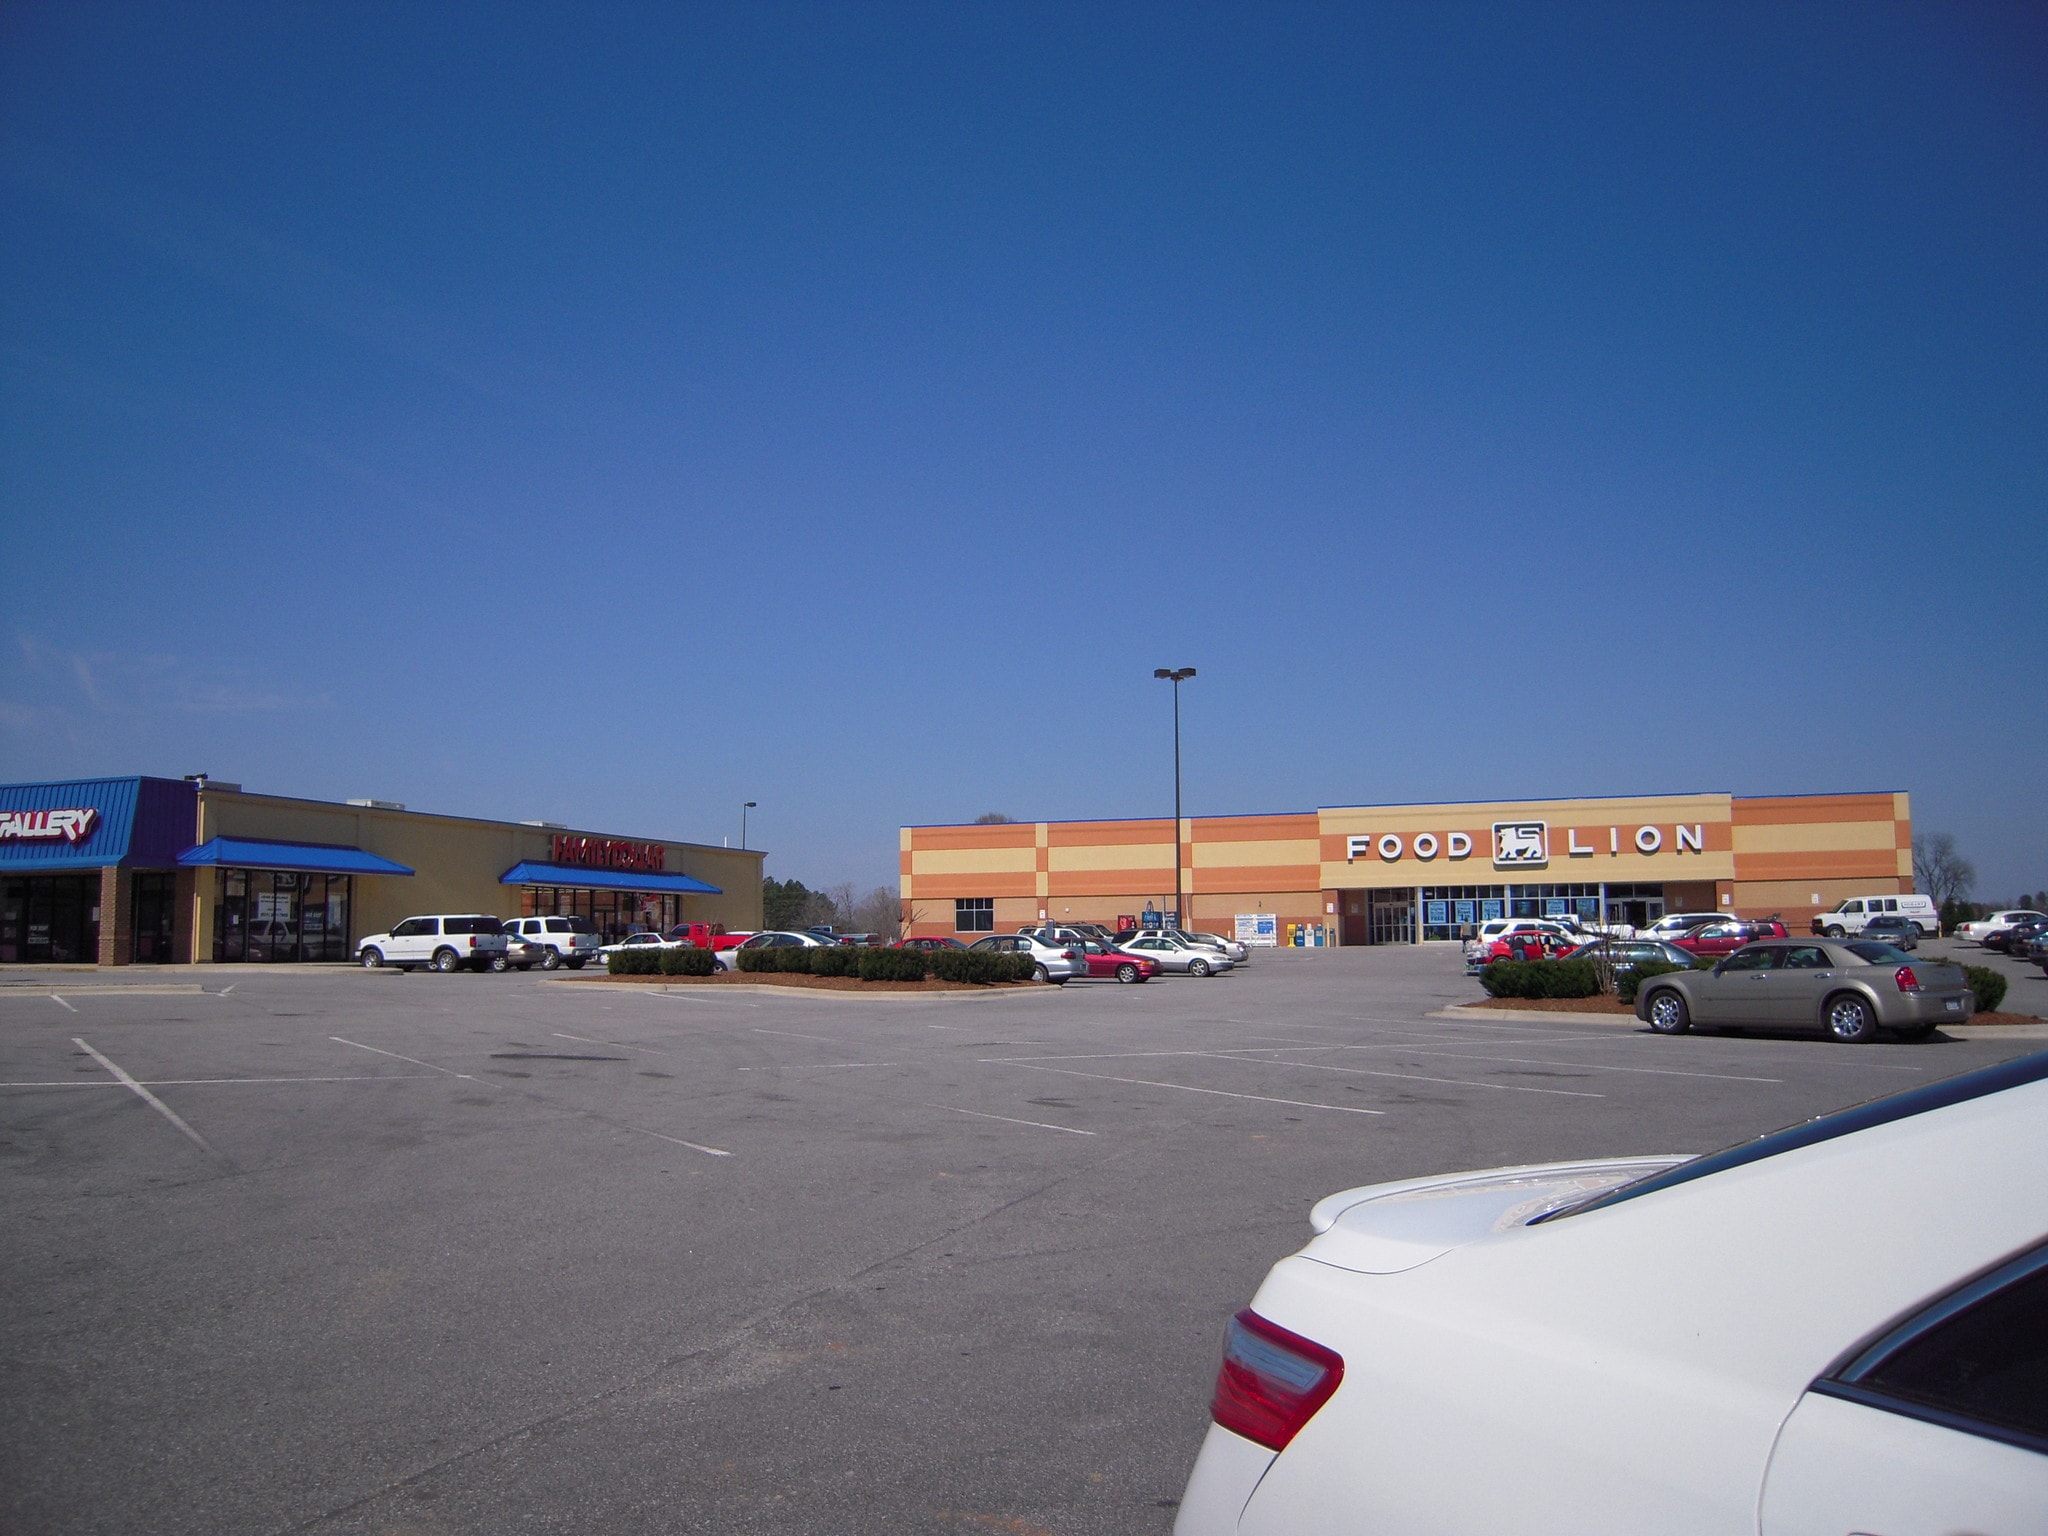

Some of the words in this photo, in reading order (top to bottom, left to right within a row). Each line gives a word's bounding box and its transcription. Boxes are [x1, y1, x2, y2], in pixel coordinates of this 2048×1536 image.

[553, 835, 612, 866] FAMILY
[611, 841, 665, 870] DOLLAR
[1346, 832, 1472, 860] FOOD
[1568, 824, 1702, 853] LION
